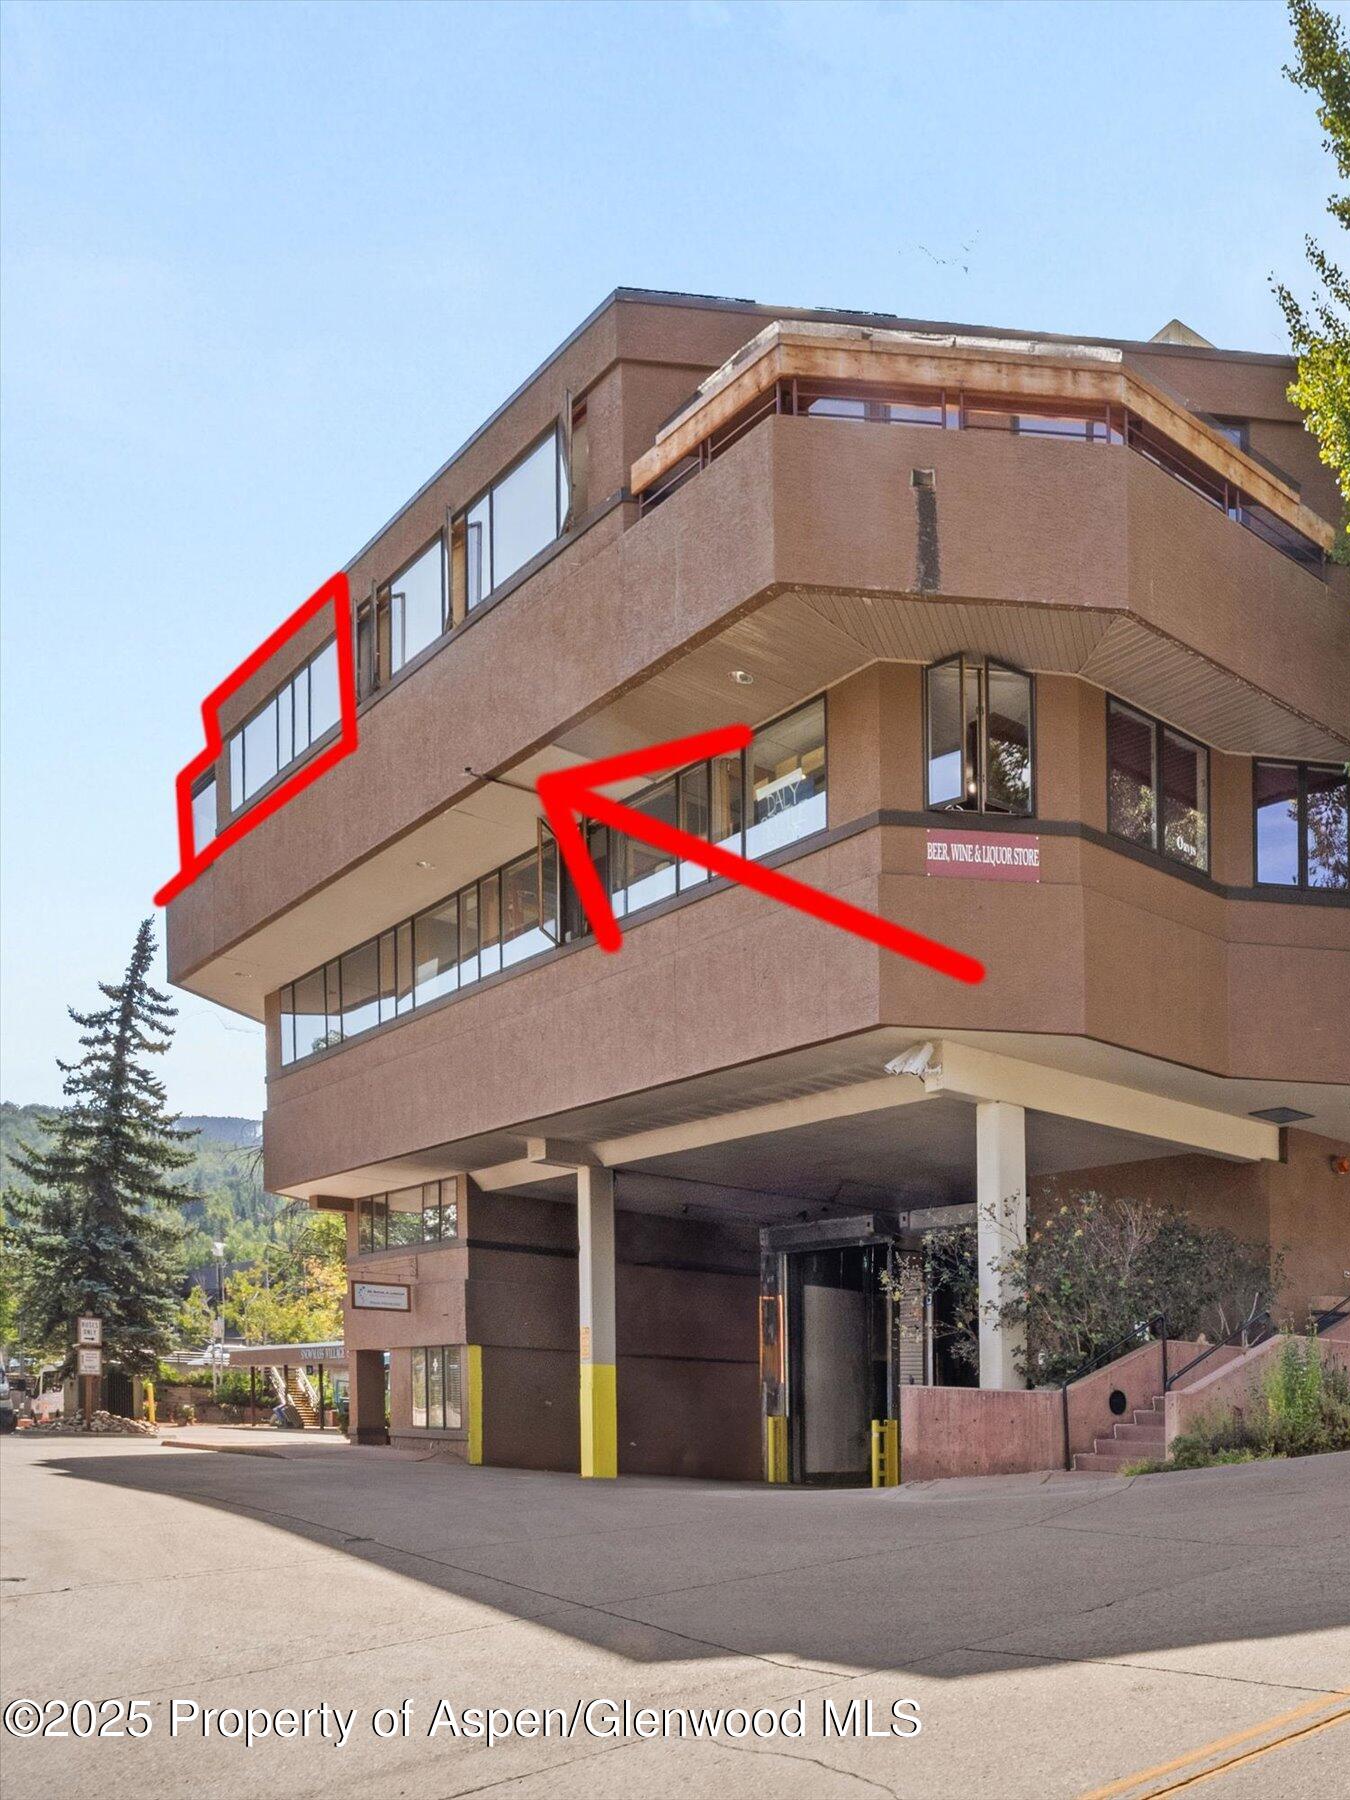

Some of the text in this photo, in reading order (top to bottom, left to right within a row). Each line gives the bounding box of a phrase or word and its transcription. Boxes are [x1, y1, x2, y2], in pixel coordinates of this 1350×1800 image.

[926, 842, 1040, 867] BEER, WINE & LIQUOR STORE
